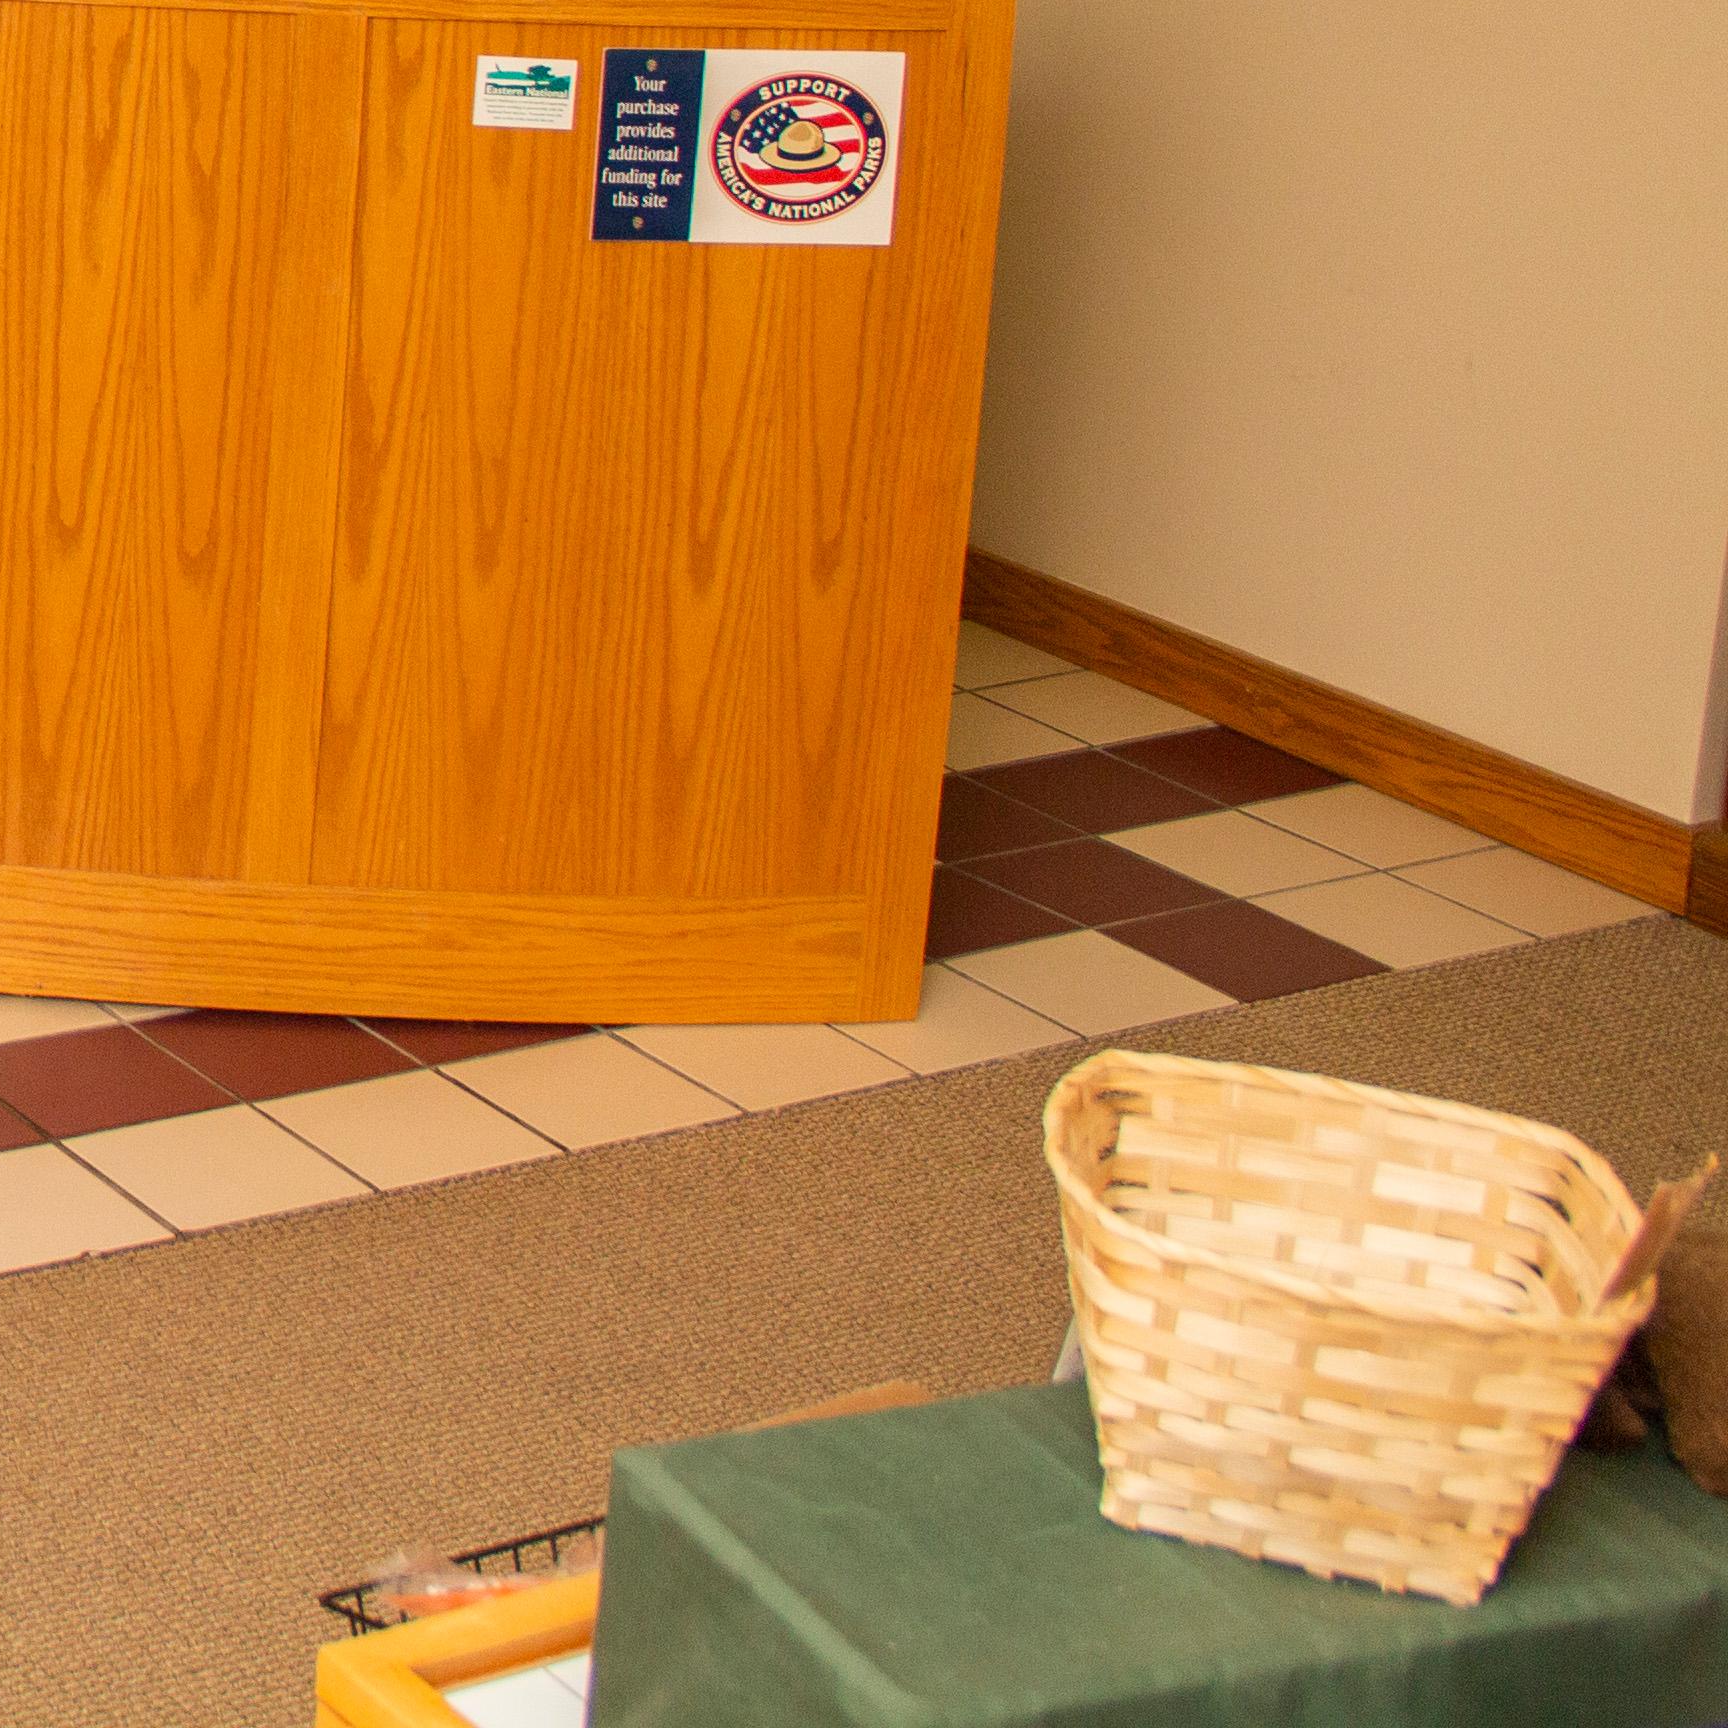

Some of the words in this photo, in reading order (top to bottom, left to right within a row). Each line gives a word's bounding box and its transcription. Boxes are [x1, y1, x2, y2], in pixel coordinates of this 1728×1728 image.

[487, 84, 523, 95] Eastern
[526, 87, 568, 99] National
[634, 75, 667, 92] Your
[759, 78, 850, 102] SUPPORT
[616, 99, 680, 118] purchase
[616, 122, 675, 142] provides
[607, 144, 680, 162] additional
[602, 167, 657, 190] funding
[660, 169, 683, 186] for
[716, 132, 766, 210] AMERICA'S
[768, 190, 857, 219] NATIONAL
[852, 136, 882, 191] PARKS
[612, 191, 639, 208] this
[642, 192, 668, 209] site
